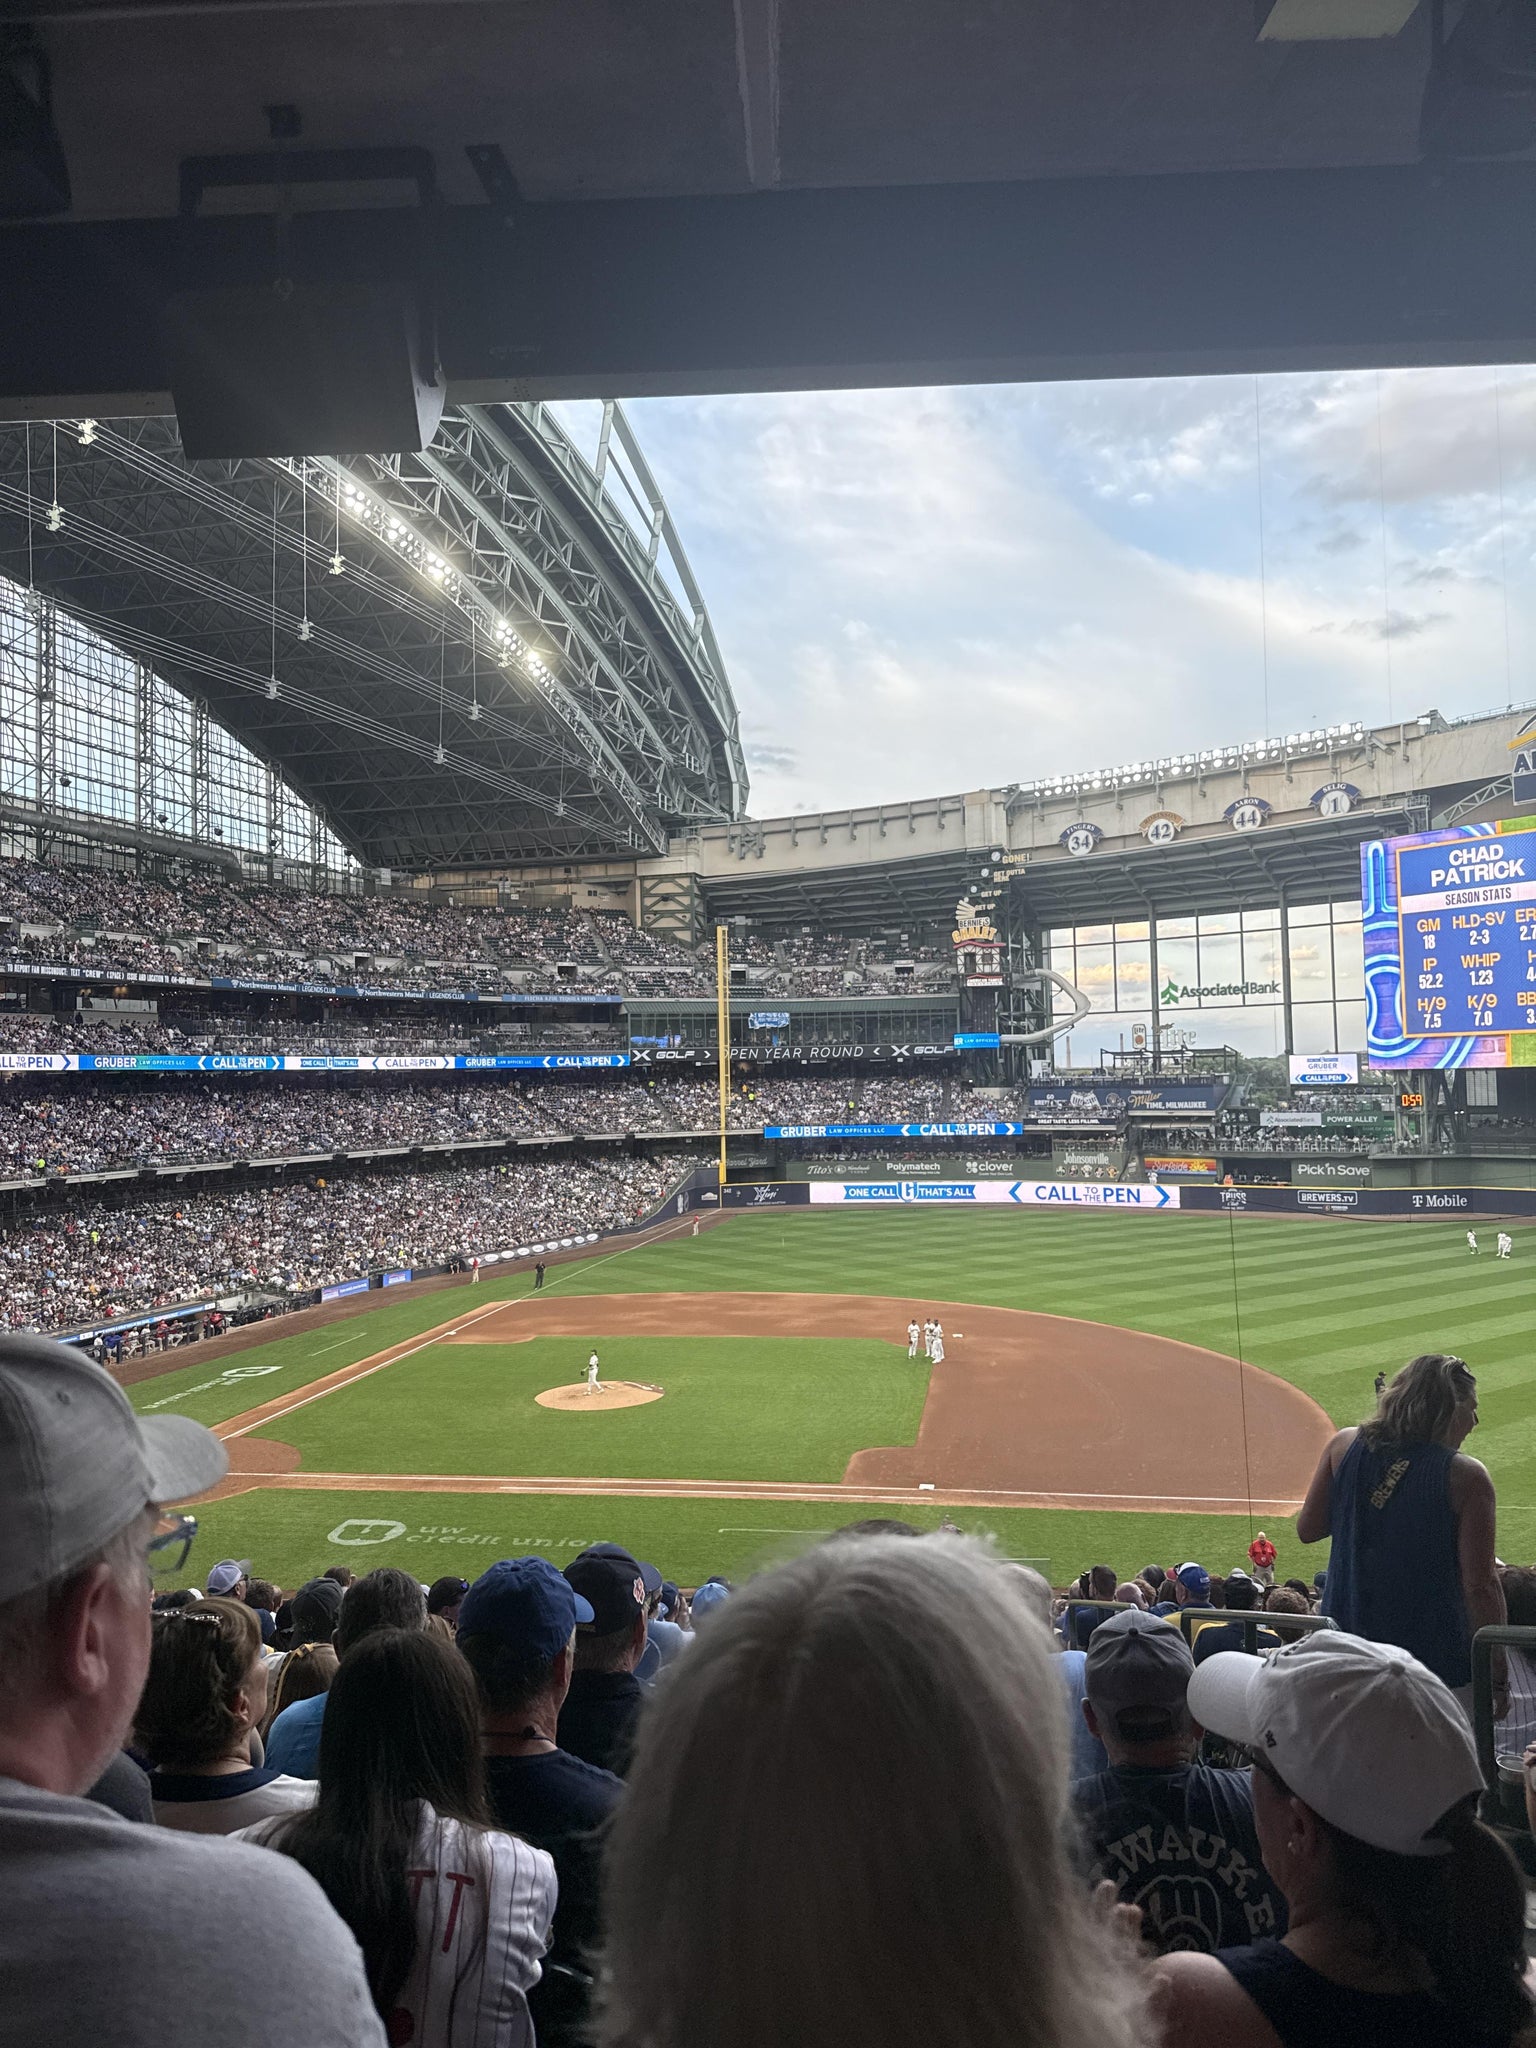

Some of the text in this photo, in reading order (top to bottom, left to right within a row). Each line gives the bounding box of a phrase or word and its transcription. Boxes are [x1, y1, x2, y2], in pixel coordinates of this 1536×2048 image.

[1322, 783, 1346, 793] SELIG
[1233, 798, 1259, 808] AARON
[1330, 797, 1340, 814] 1
[1236, 810, 1257, 828] 44
[1066, 824, 1095, 834] FINGERS
[1150, 823, 1171, 839] 42
[1070, 834, 1090, 851] 34
[1002, 853, 1030, 864] GONE!
[1448, 843, 1504, 866] CHAD
[1431, 858, 1526, 887] PATRICK
[1445, 886, 1512, 906] SEASON STATS
[959, 917, 990, 928] BERNIE'S
[1416, 917, 1441, 933] GM
[1452, 910, 1506, 929] HLD-SV
[951, 925, 997, 944] CHALET
[1422, 934, 1436, 950] 18
[1469, 929, 1490, 945] 2-3
[1423, 957, 1438, 972] IP
[1460, 951, 1501, 969] WHIP
[70, 968, 81, 977] TEXT
[82, 969, 104, 978] "CREW"
[1418, 973, 1444, 989] 52.2
[1469, 969, 1494, 986] 1.23
[239, 981, 276, 990] Northwestern
[278, 983, 297, 991] Mutual
[323, 986, 337, 994] CLUB
[364, 990, 402, 998] Northwestern
[429, 992, 452, 1000] LEGENDS
[452, 993, 465, 1001] CLUB
[1417, 996, 1447, 1012] H/9
[1467, 993, 1498, 1010] K/9
[1423, 1013, 1442, 1029] 7.5
[1473, 1011, 1493, 1027] 7.0
[655, 1050, 695, 1059] GOLF
[765, 1047, 802, 1059] YEAR
[810, 1046, 864, 1058] ROUND
[913, 1045, 954, 1055] GOLF
[28, 1057, 53, 1068] PEN
[94, 1056, 137, 1068] GRUBER
[212, 1057, 238, 1068] CALL
[249, 1057, 267, 1068] PEN
[385, 1058, 437, 1068] CALL PEN
[465, 1058, 497, 1068] GRUBER
[557, 1056, 581, 1067] CALL
[592, 1056, 612, 1066] PEN
[1128, 1091, 1163, 1109] Miller
[1146, 1101, 1207, 1109] TIME, MILWAUKEE
[1401, 1094, 1423, 1107] 0:59
[780, 1126, 827, 1137] GRUBER
[919, 1124, 954, 1136] CALL
[970, 1123, 996, 1135] PEN
[1063, 1152, 1109, 1166] Johnsonville
[806, 1164, 834, 1175] Tito's
[886, 1162, 941, 1173] Polymatech
[978, 1160, 1014, 1172] clover
[1152, 1160, 1188, 1171] Surfside
[1297, 1162, 1371, 1177] Pick'n Save
[848, 1187, 972, 1197] ONE CALL THAT'S ALL
[1035, 1185, 1141, 1204] CALL TO THE PEN
[1426, 1194, 1468, 1208] Mobile
[1370, 1457, 1410, 1510] BREWERS
[419, 1525, 468, 1534] uw
[406, 1534, 501, 1545] credit
